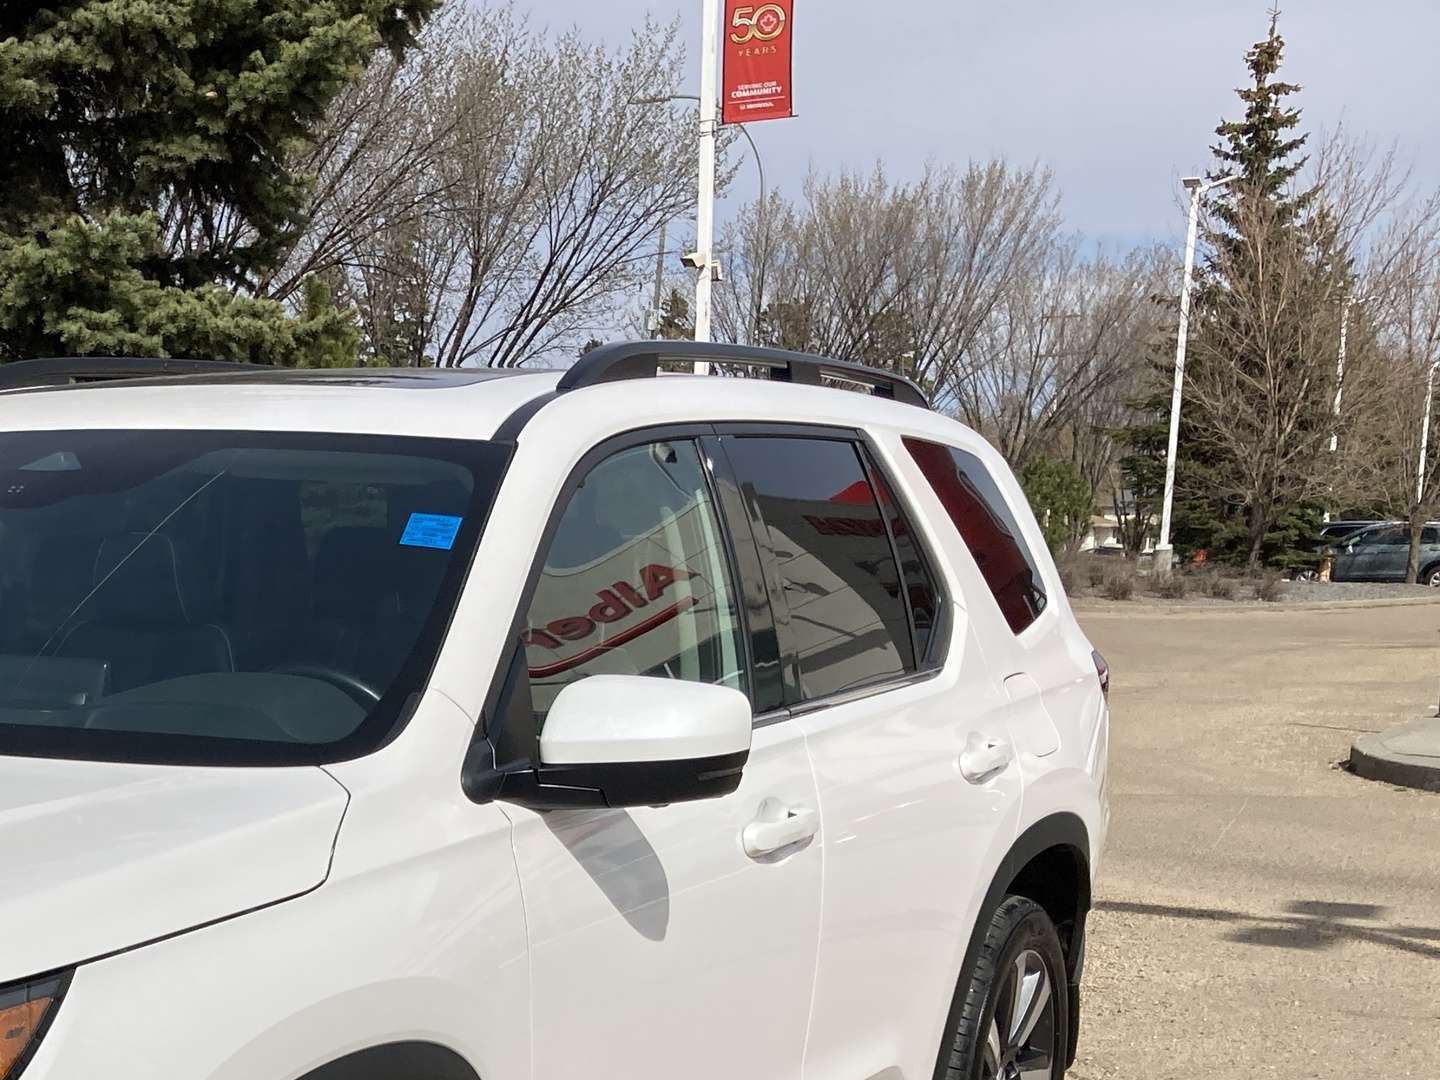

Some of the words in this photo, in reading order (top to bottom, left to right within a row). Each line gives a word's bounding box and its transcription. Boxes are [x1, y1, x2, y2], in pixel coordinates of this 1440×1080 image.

[730, 3, 786, 44] 50
[738, 46, 777, 57] YEARS
[731, 86, 782, 98] COMMUNITY
